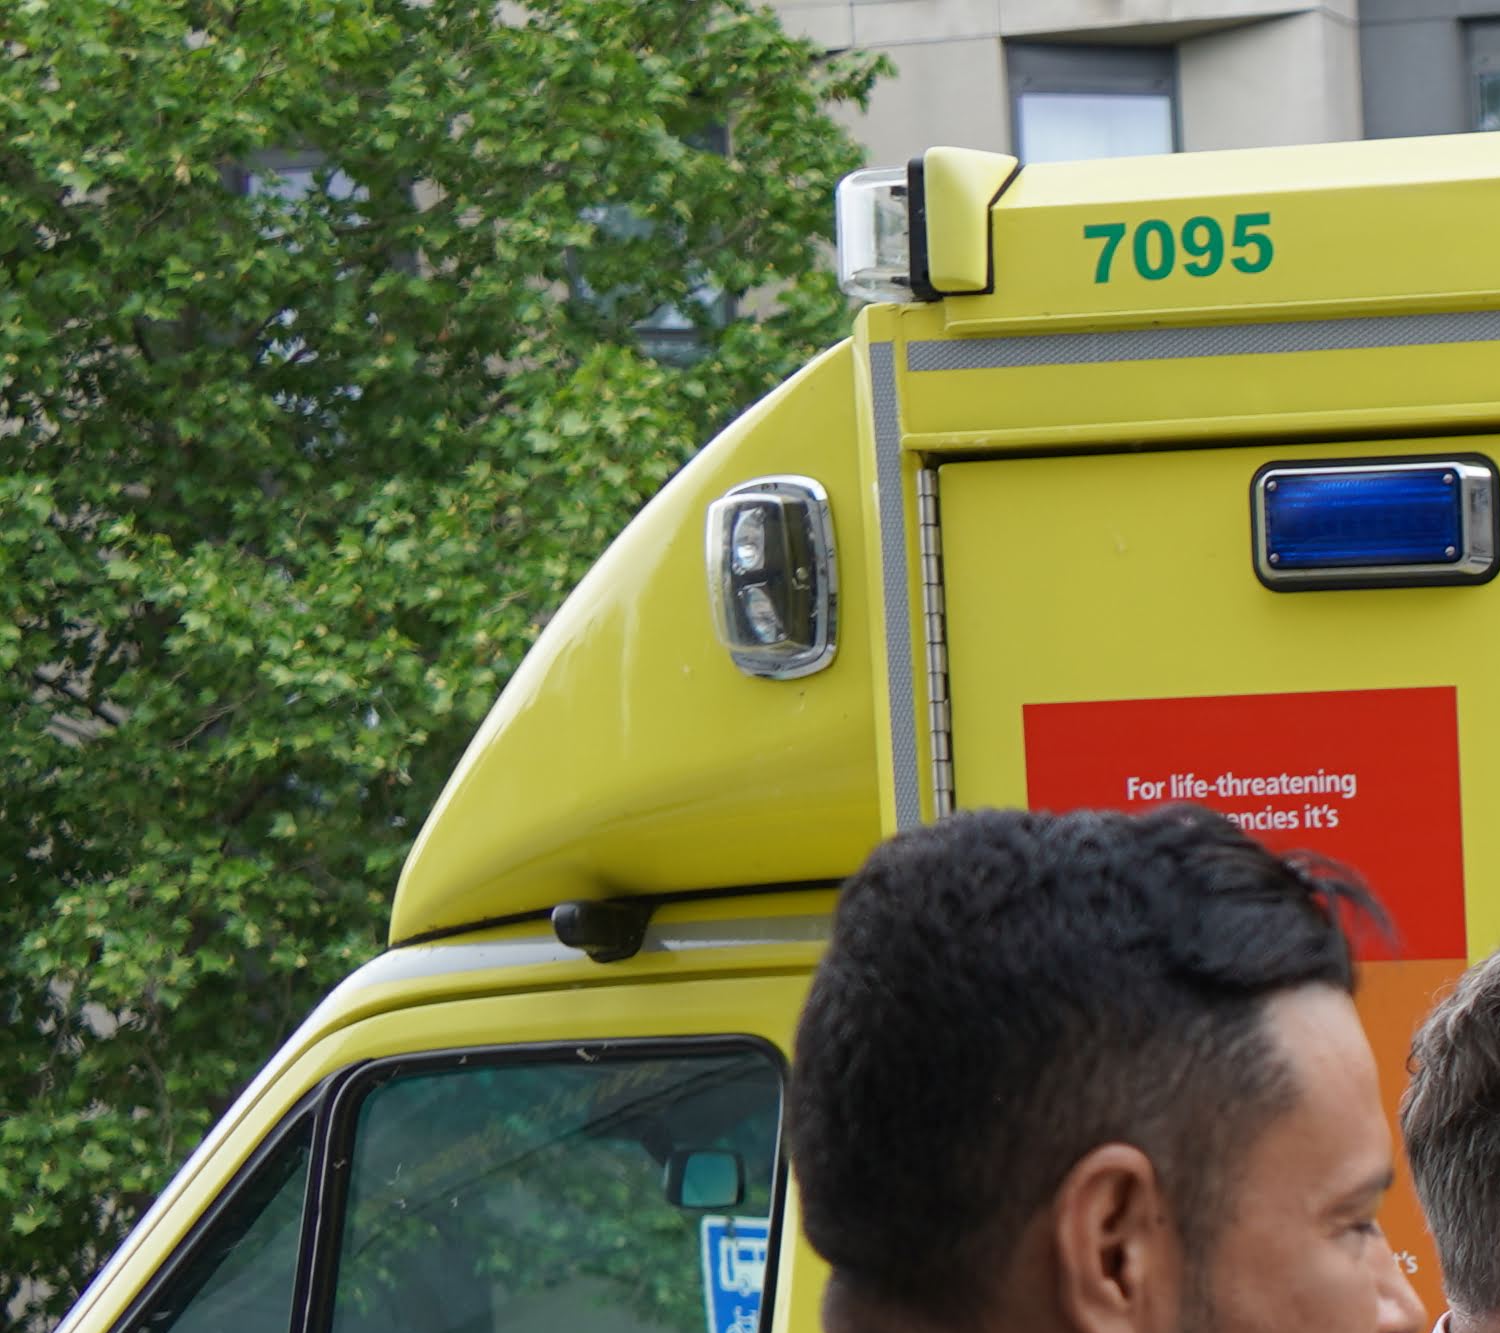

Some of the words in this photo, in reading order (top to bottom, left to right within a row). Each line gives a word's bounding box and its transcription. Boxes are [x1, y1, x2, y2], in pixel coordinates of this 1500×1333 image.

[1083, 212, 1274, 284] 7095
[1126, 776, 1165, 800] For
[1170, 768, 1356, 799] life-threatening
[1227, 804, 1299, 830] encies
[1304, 802, 1339, 829] it's
